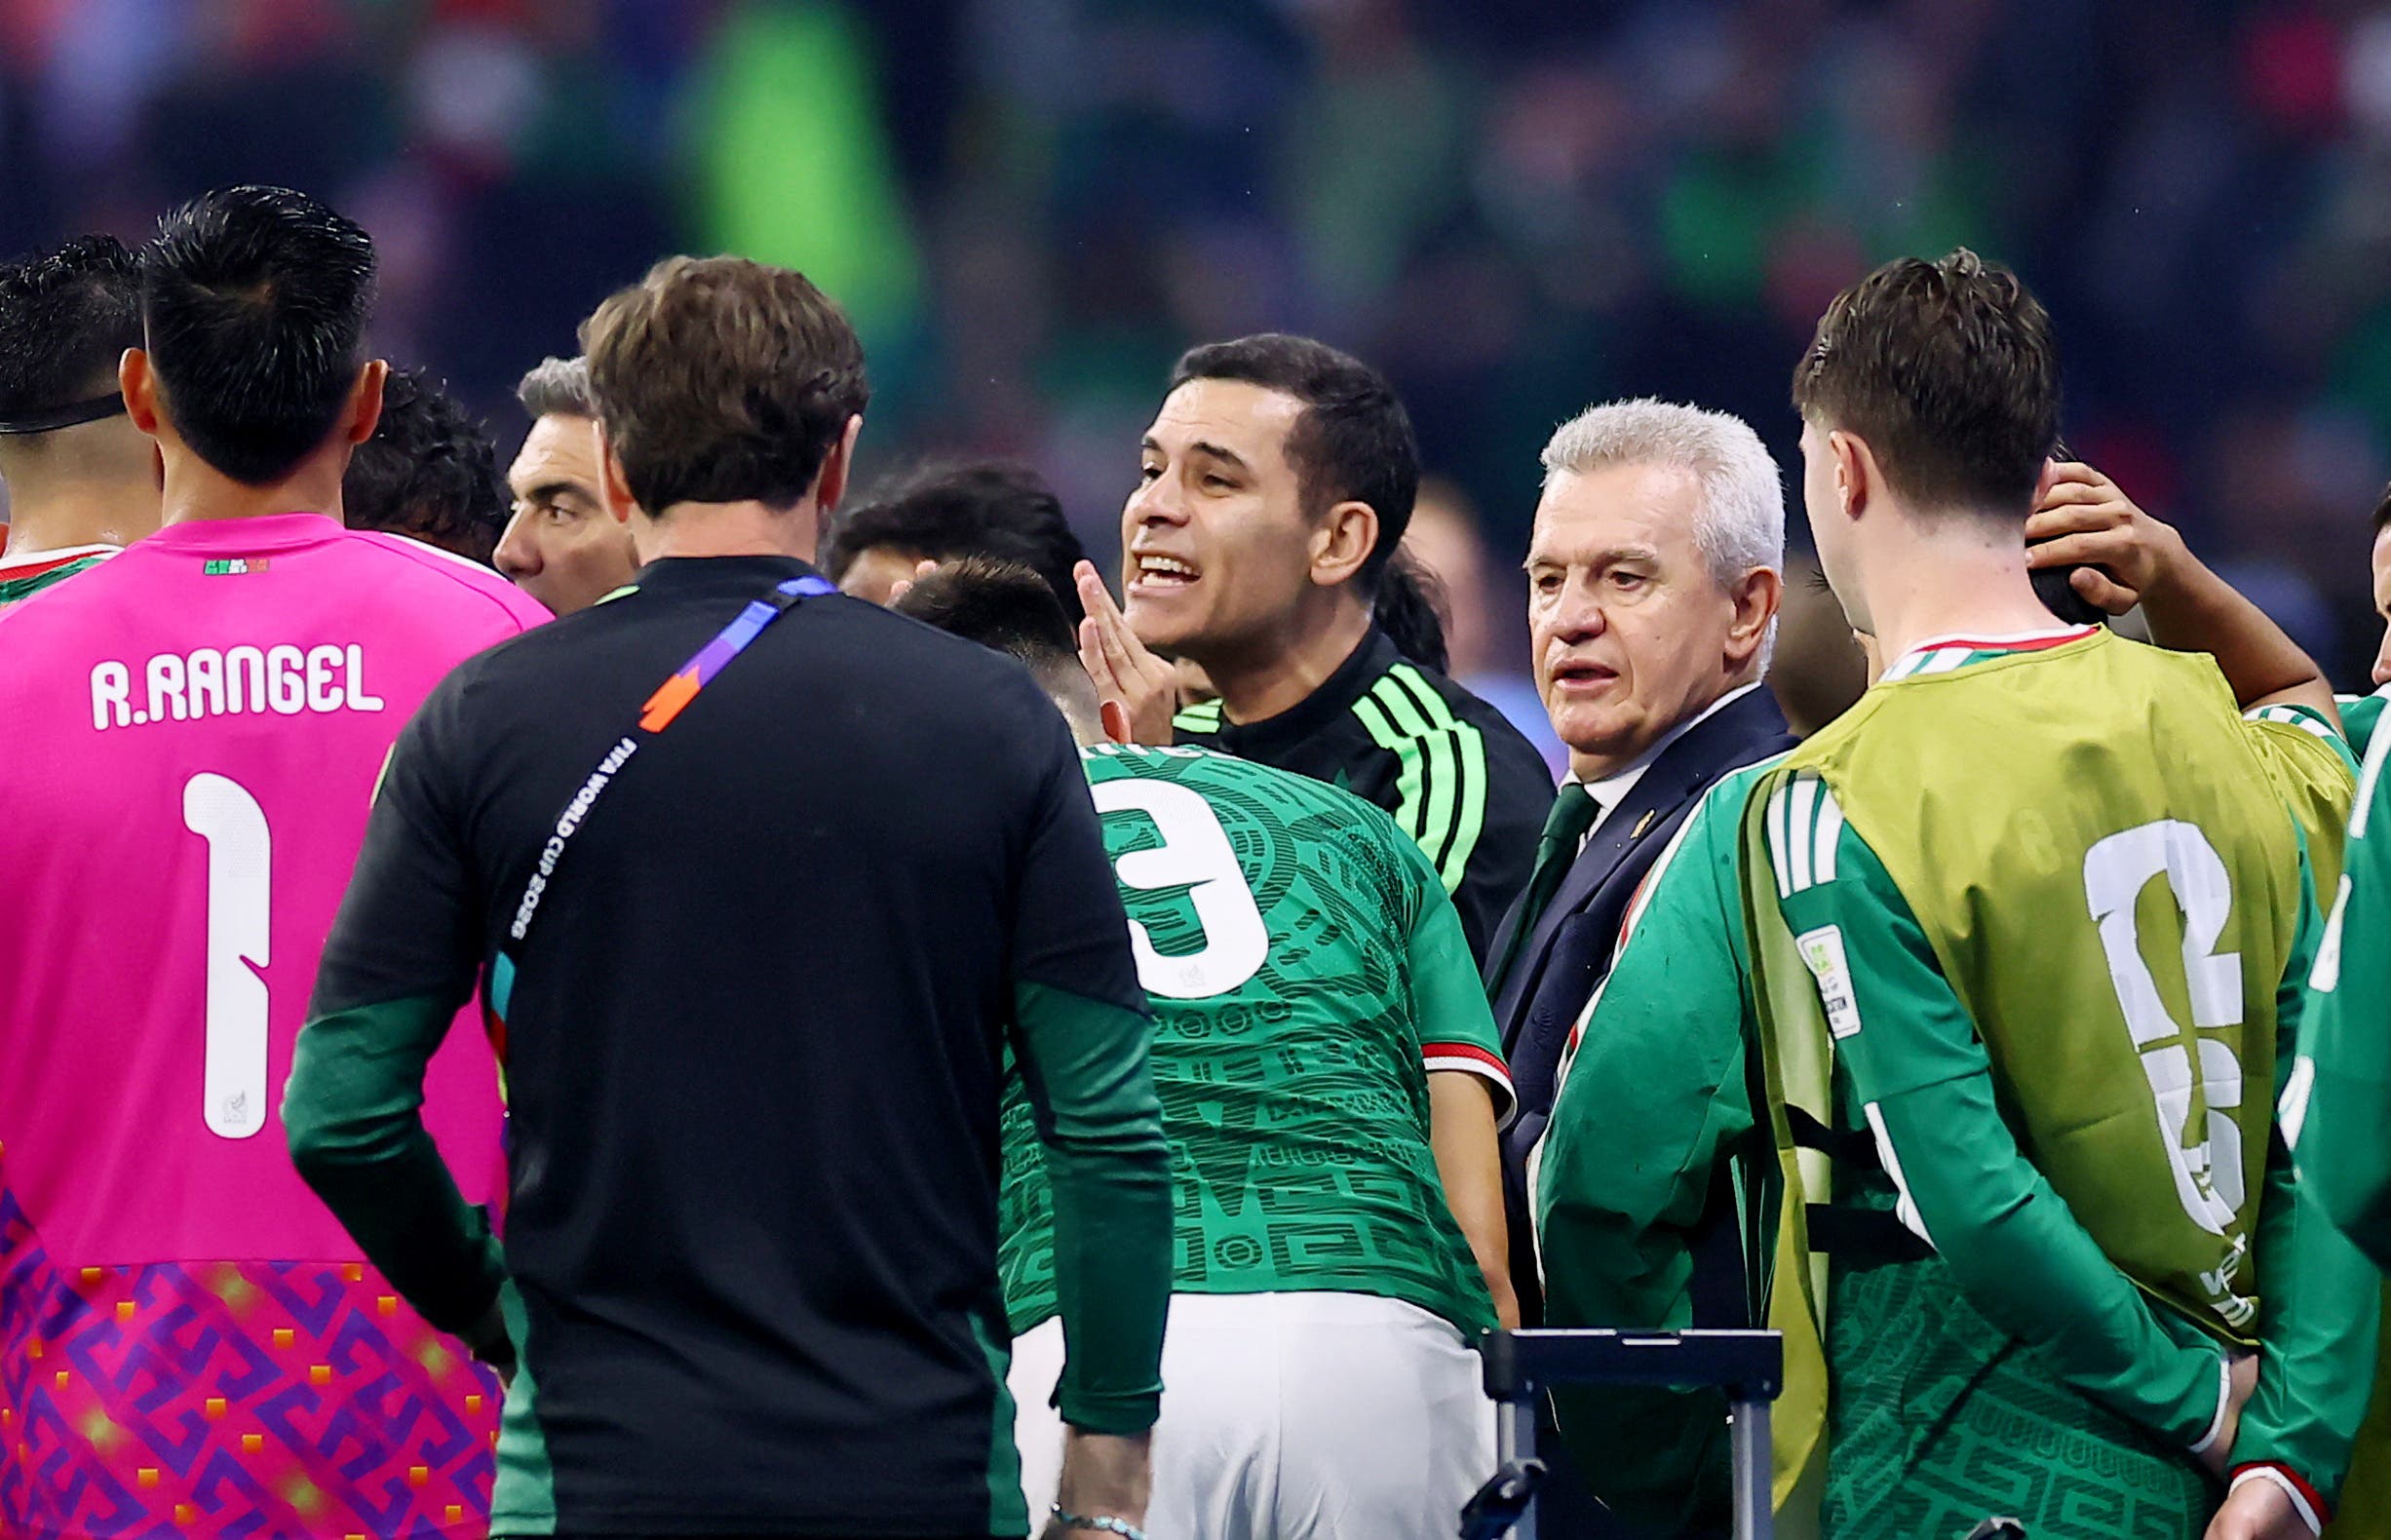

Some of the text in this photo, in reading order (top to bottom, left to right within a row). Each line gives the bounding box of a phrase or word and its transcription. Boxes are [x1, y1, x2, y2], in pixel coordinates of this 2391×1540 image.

[91, 643, 385, 731] R.RANGEL
[511, 737, 637, 941] FIFA WORLD CUP 2026
[183, 773, 272, 1138] 1
